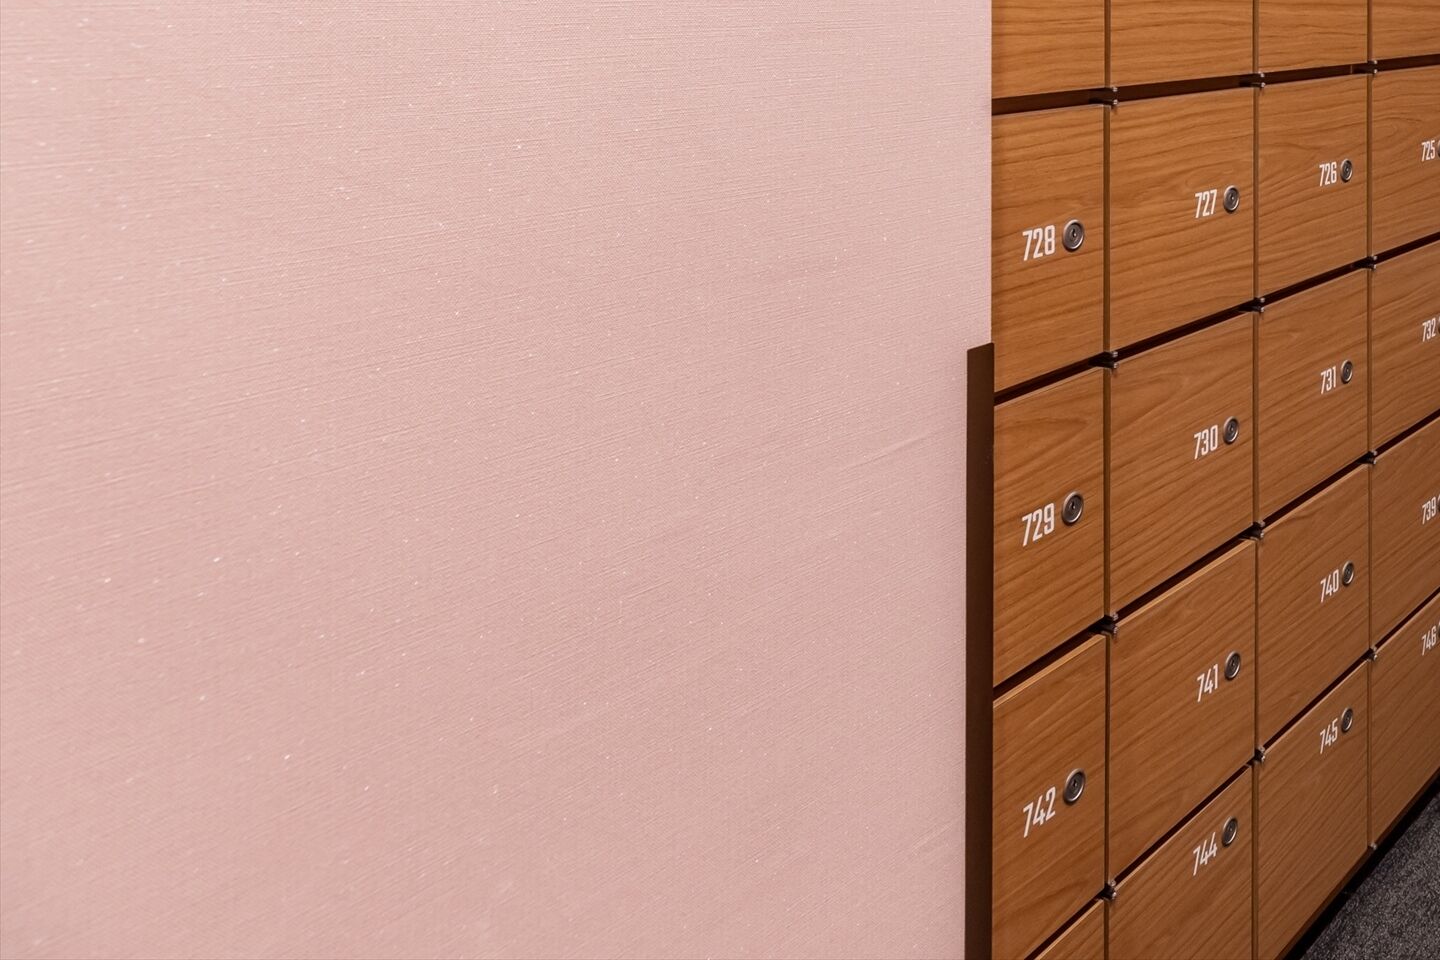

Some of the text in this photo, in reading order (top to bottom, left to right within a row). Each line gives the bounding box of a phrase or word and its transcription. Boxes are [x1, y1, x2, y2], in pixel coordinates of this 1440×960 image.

[1421, 139, 1436, 162] 725
[1319, 161, 1337, 187] 726
[1194, 188, 1218, 219] 727
[1022, 224, 1056, 261] 728
[1422, 317, 1437, 342] 732
[1320, 365, 1337, 394] 731
[1193, 424, 1219, 460] 730
[1021, 502, 1055, 547] 729
[1421, 496, 1437, 525] 739
[1320, 568, 1340, 603] 740
[1421, 625, 1437, 656] 746
[1196, 663, 1219, 703] 741
[1319, 717, 1338, 754] 745
[1022, 786, 1056, 838] 742
[1192, 831, 1218, 876] 744
